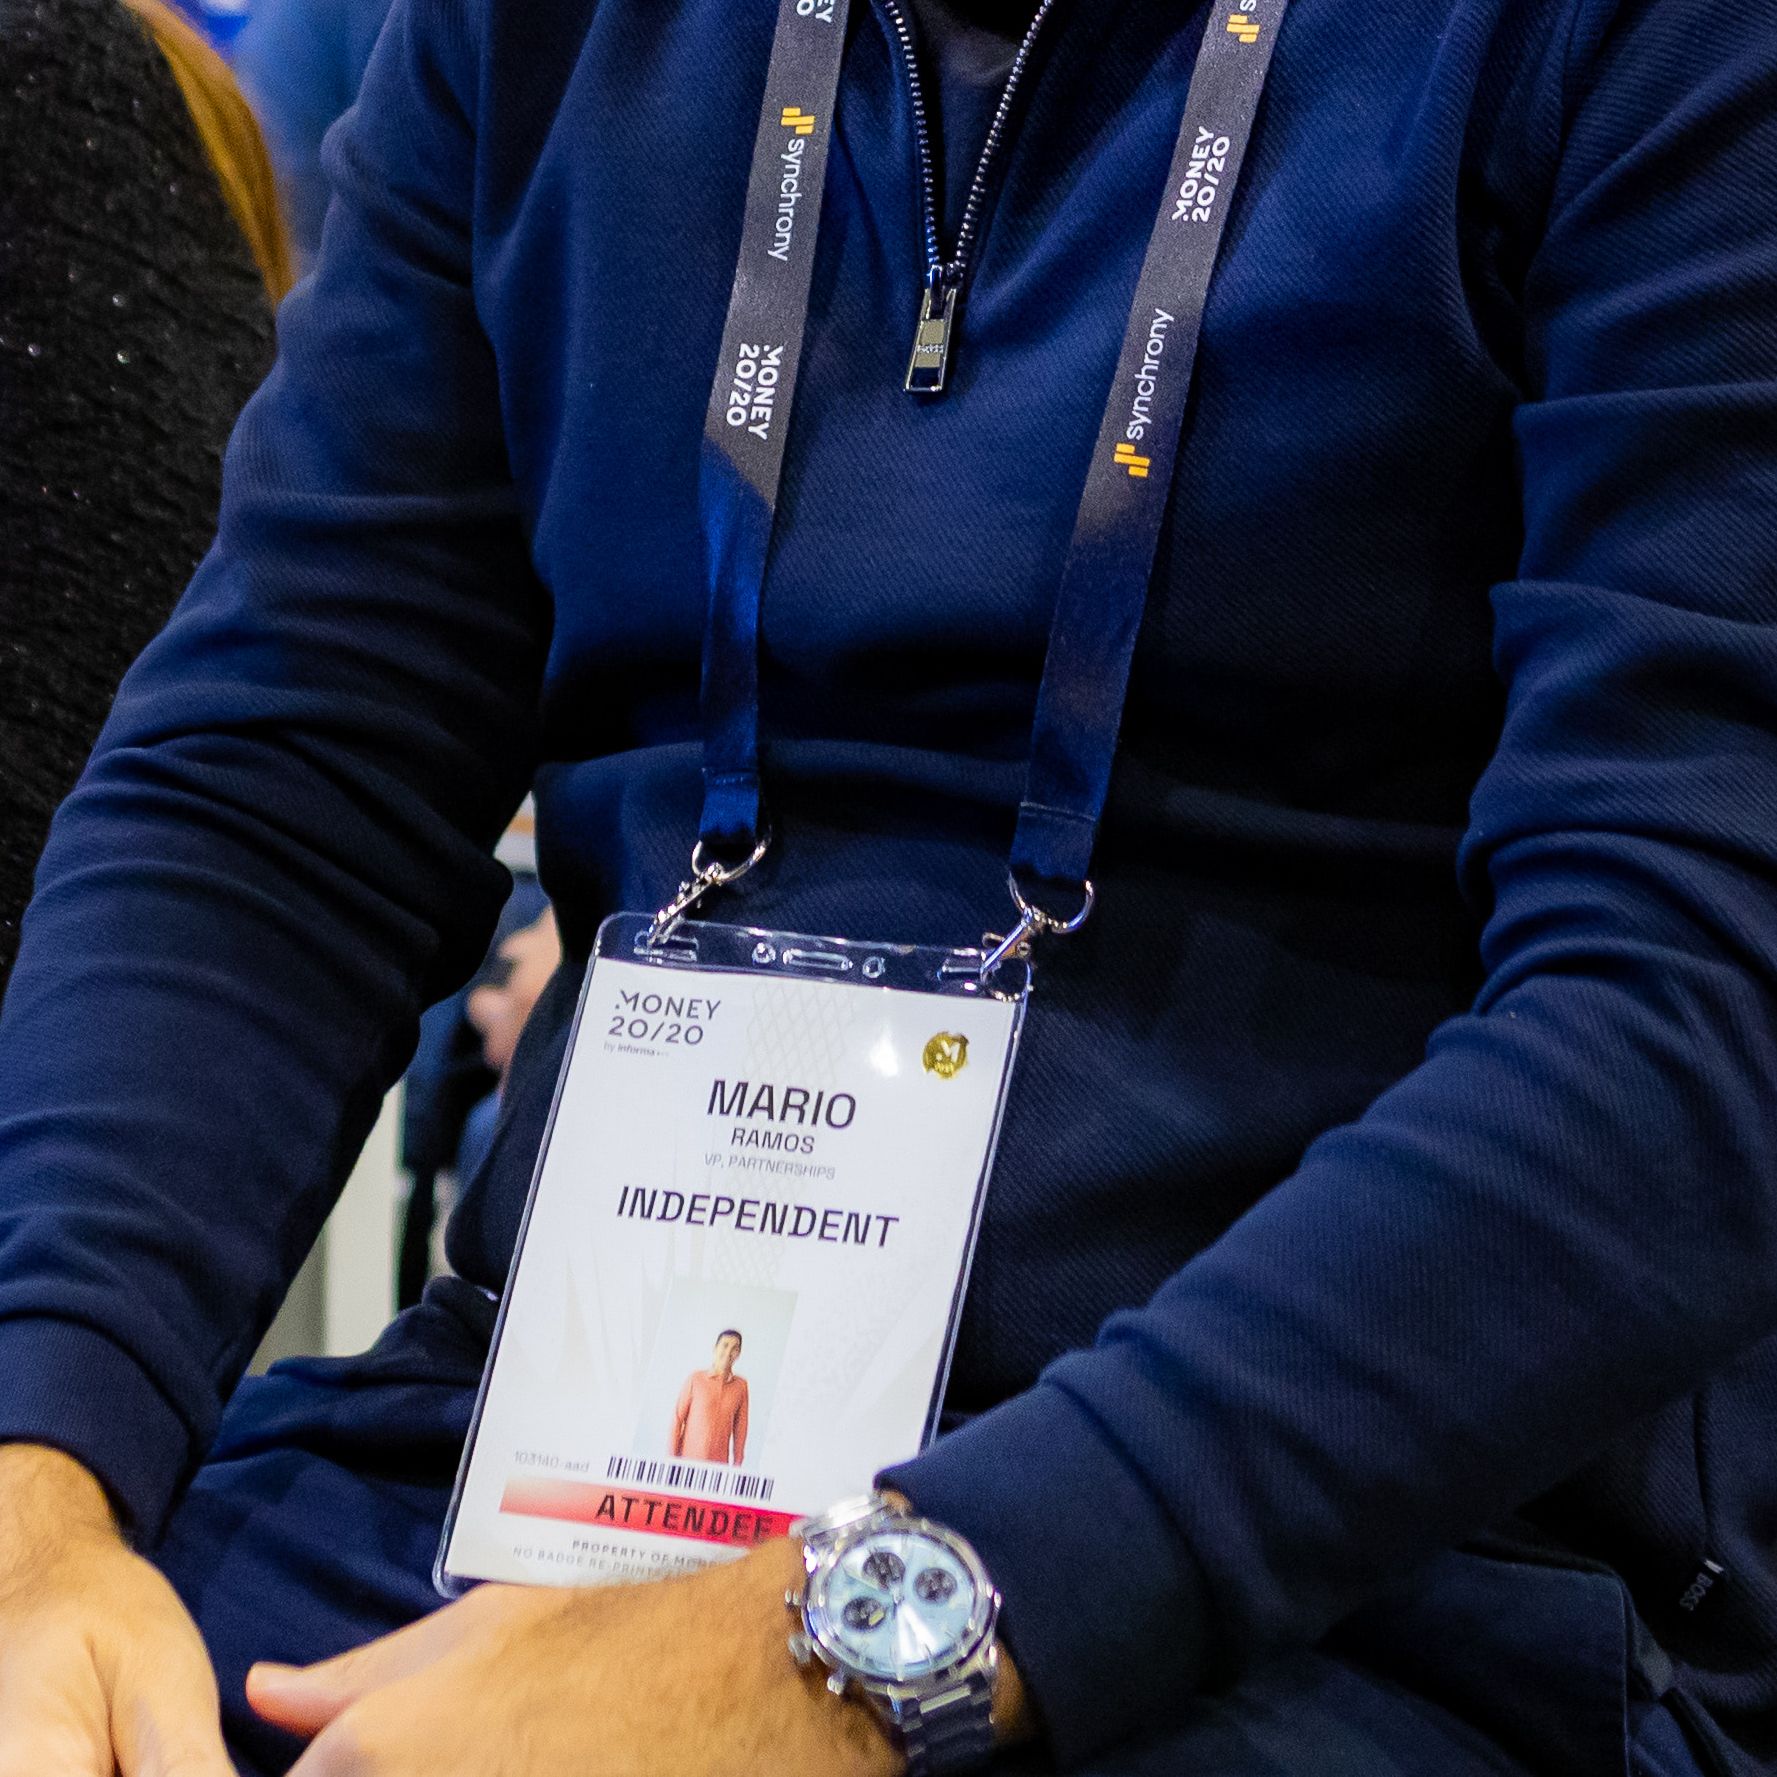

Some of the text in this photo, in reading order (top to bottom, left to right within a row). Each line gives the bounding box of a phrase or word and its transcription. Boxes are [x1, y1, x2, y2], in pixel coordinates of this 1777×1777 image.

[767, 138, 805, 261] synchrony
[1171, 126, 1214, 221] MONEY
[1191, 136, 1231, 222] 20/20
[726, 343, 760, 427] 20/20
[748, 345, 784, 440] MONEY
[1126, 307, 1174, 441] synchrony
[608, 1015, 703, 1045] 20/20
[615, 989, 721, 1020] MONEY
[706, 1079, 857, 1129] MARIO
[704, 1153, 837, 1180] VP, PARTNERSHIPS
[730, 1126, 816, 1155] RAMOS
[616, 1185, 901, 1248] INDEPENDENT
[513, 1547, 533, 1559] NO
[538, 1550, 584, 1567] BADGE
[572, 1540, 646, 1560] PROPERTY
[651, 1553, 669, 1565] OF
